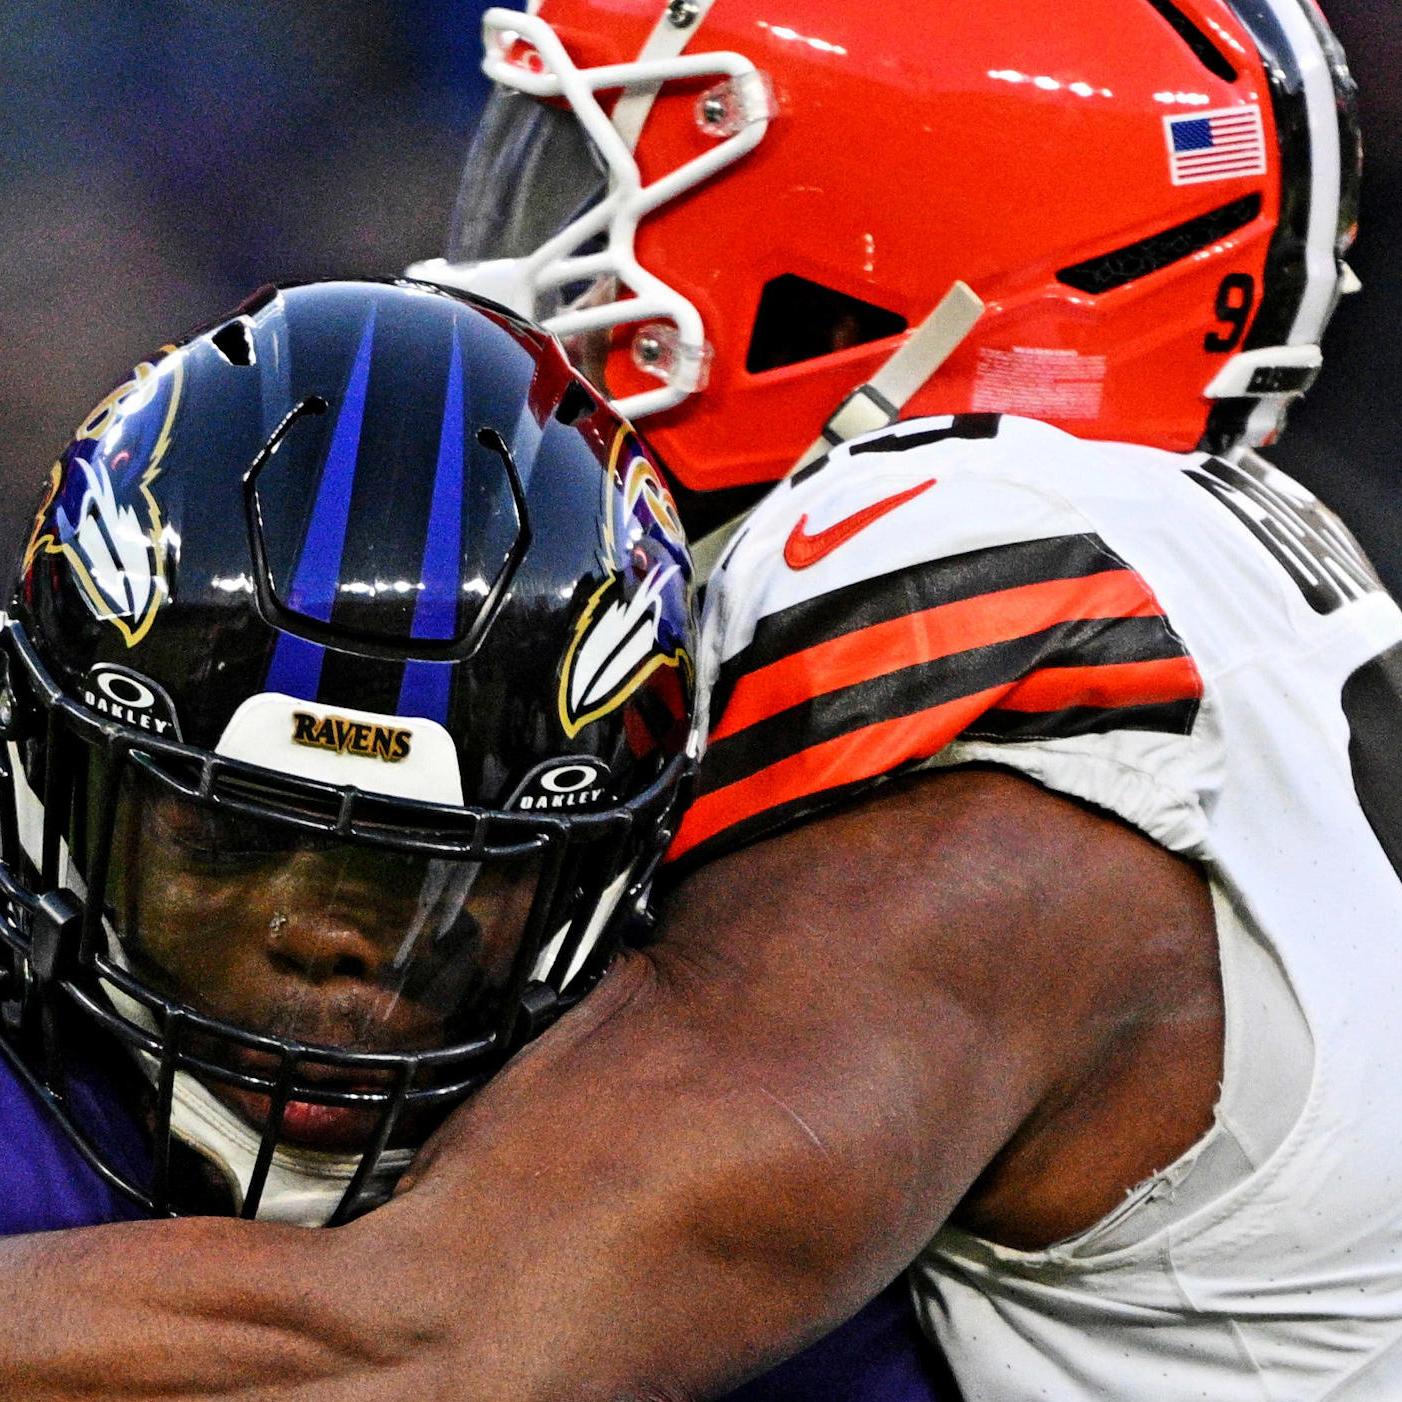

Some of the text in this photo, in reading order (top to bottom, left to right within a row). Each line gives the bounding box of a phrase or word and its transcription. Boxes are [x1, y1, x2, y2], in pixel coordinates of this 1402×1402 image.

[1204, 273, 1254, 352] 9
[85, 690, 168, 734] OAKLEY
[292, 710, 413, 763] RAVENS
[520, 788, 602, 810] OAKLEY
